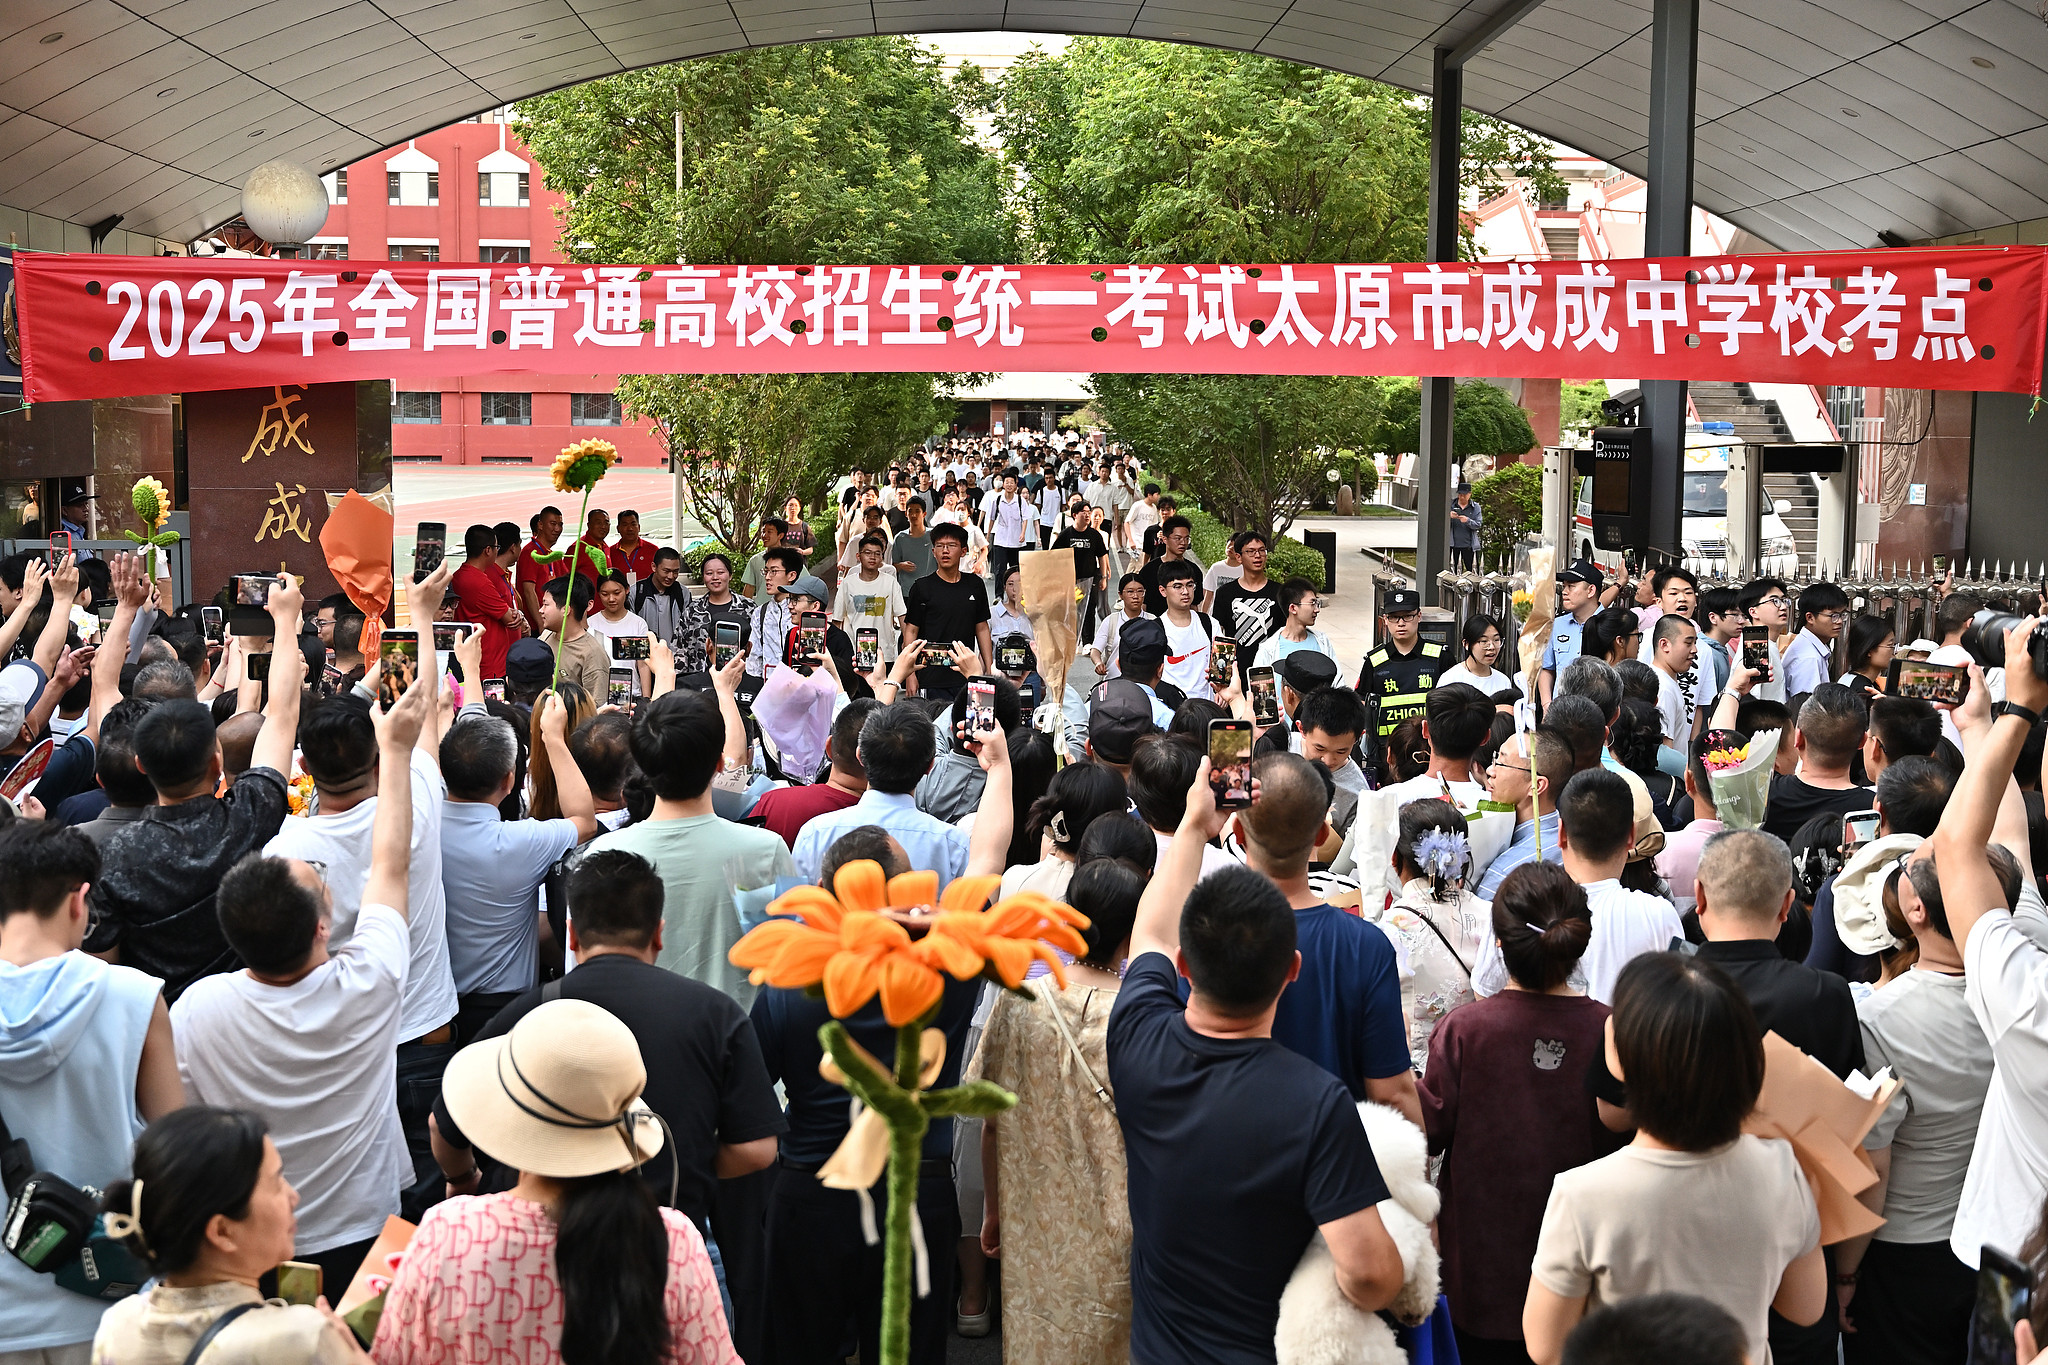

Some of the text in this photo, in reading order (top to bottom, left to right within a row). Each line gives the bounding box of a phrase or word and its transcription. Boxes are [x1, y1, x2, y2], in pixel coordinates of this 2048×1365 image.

[107, 263, 1976, 362] 2025年全国普通高校招生统一考试太原市成成中学校考点
